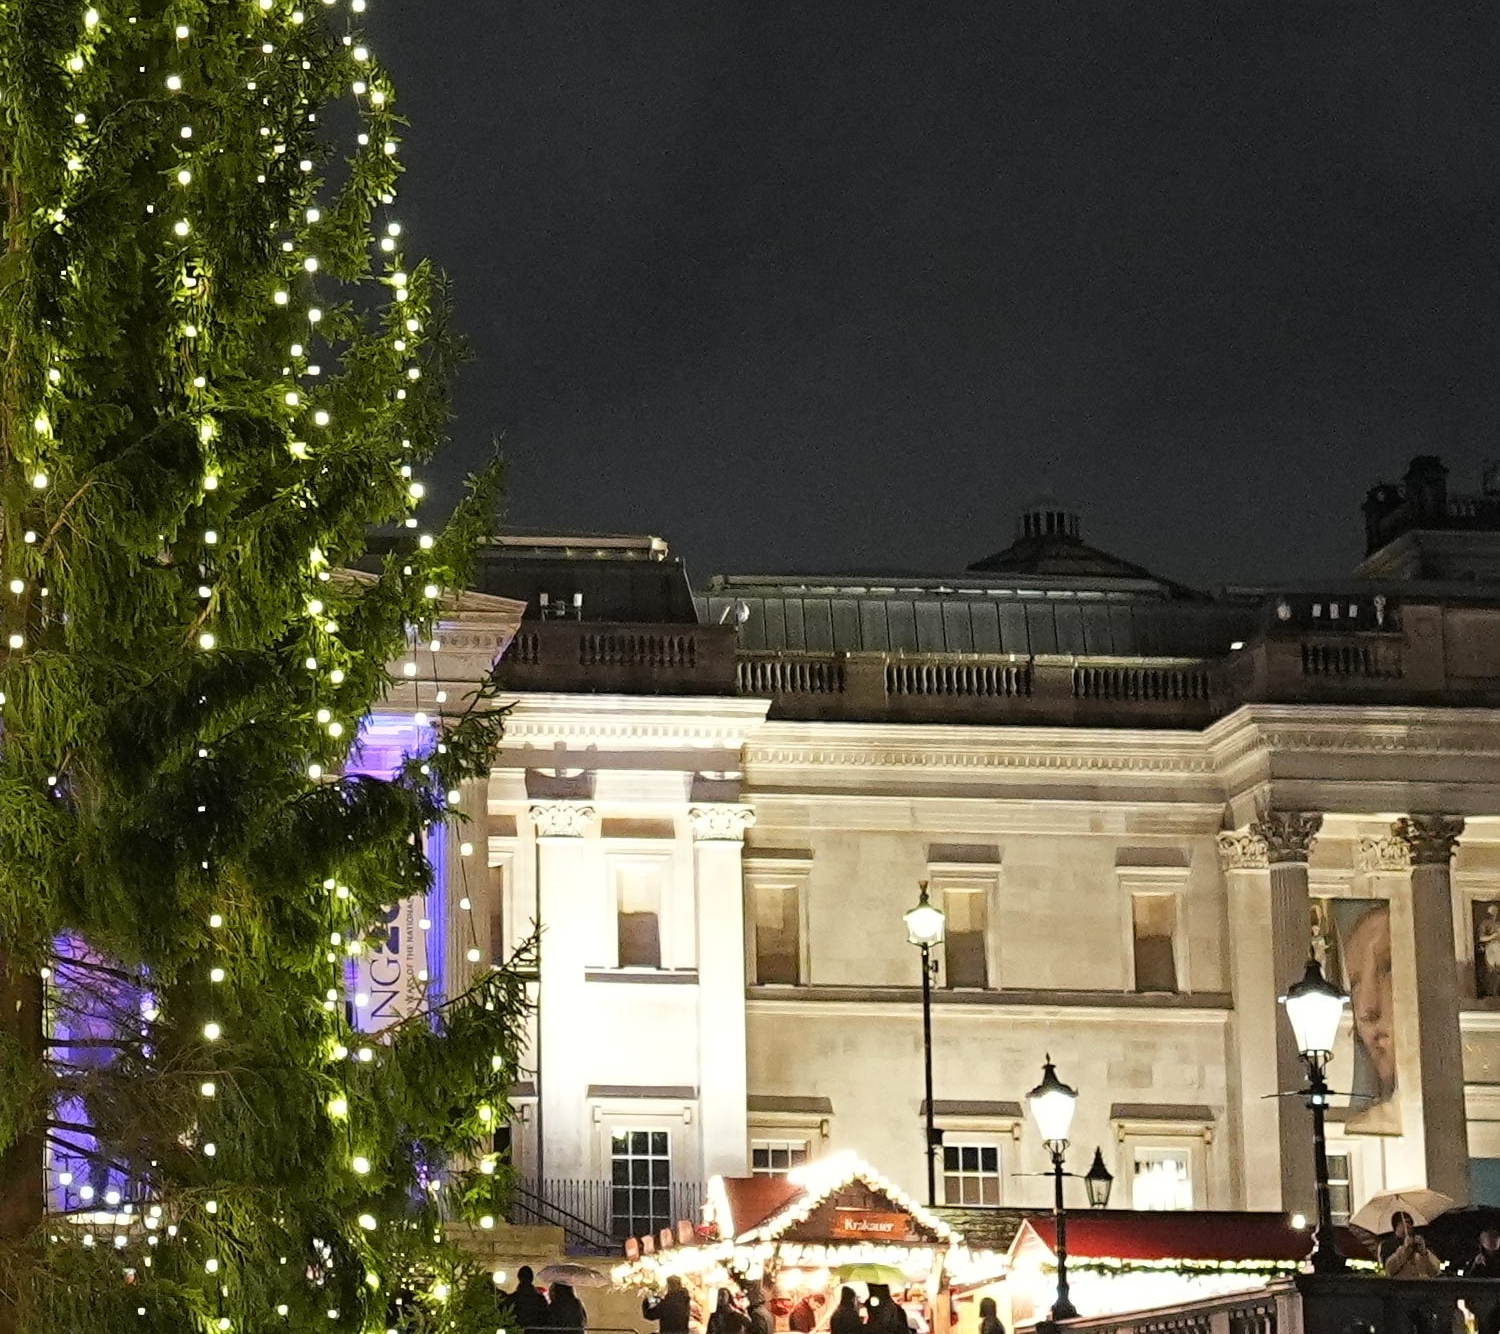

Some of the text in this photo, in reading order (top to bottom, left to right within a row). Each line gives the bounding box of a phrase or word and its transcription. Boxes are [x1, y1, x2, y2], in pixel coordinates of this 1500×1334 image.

[406, 946, 414, 961] THE
[406, 964, 414, 975] OF
[844, 1218, 894, 1233] Krakauer
